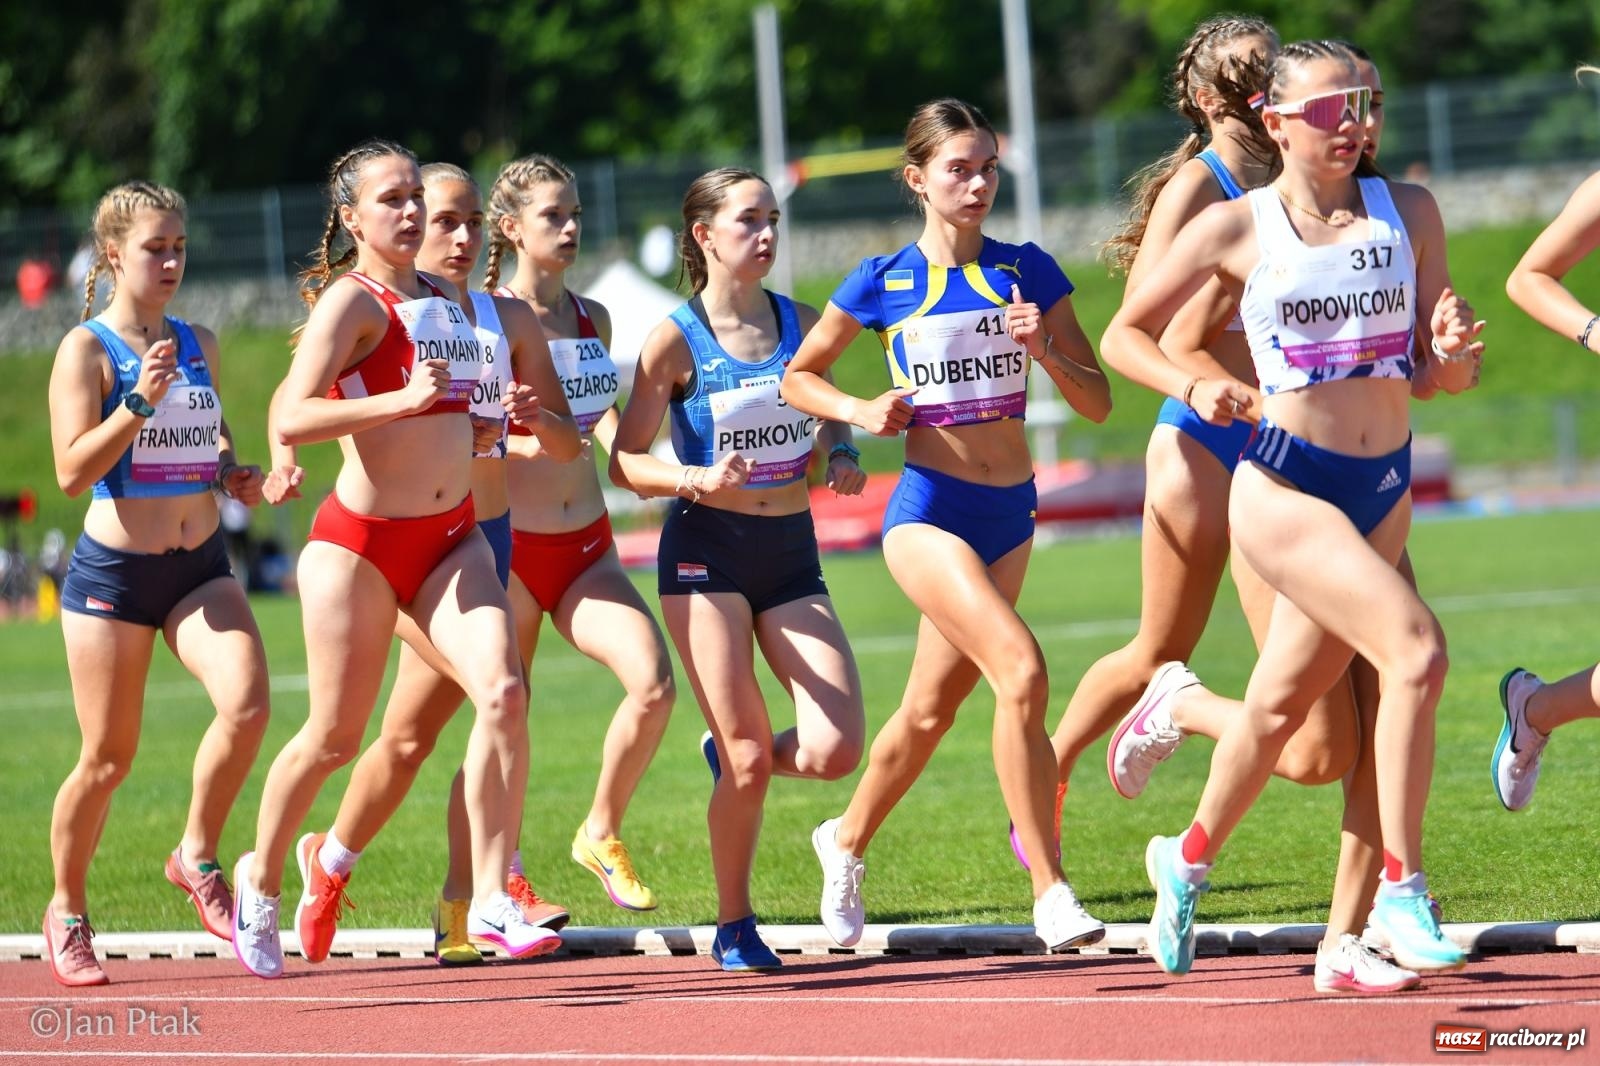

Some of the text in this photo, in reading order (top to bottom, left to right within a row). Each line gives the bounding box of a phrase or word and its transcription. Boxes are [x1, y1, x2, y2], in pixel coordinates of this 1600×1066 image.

[1350, 246, 1393, 271] 317
[1281, 281, 1406, 326] POPOVICOVÁ
[975, 312, 1009, 337] 41
[418, 336, 480, 362] DOLMÁNY
[575, 342, 604, 362] 218
[912, 351, 1023, 387] DUBENETS
[188, 391, 215, 410] 518
[138, 421, 217, 448] FRANJKOVIĆ
